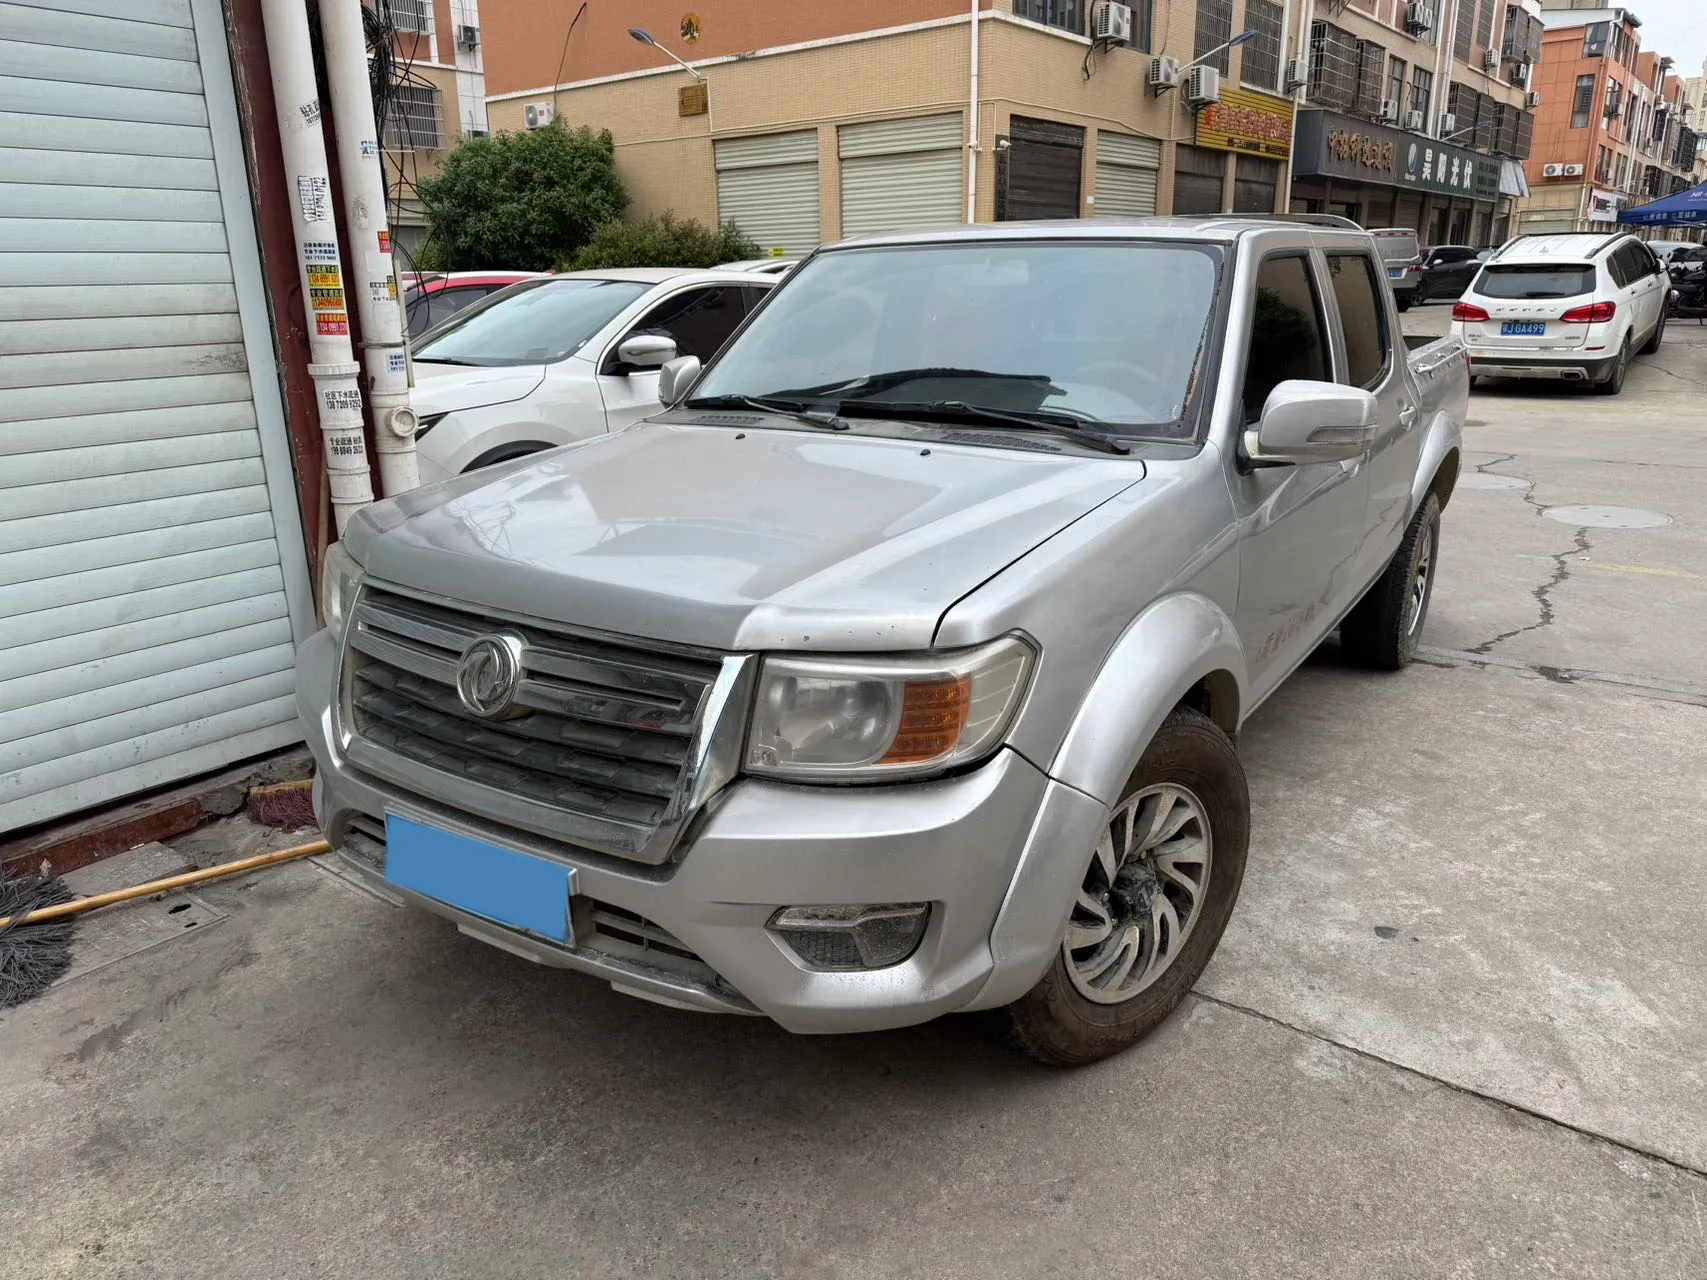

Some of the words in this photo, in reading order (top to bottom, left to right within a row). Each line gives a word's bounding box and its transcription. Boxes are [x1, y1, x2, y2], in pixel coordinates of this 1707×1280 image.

[1422, 148, 1473, 189] 昊阳光伏
[325, 389, 359, 399] 社区下水疏通
[330, 436, 352, 446] 专业疏通
